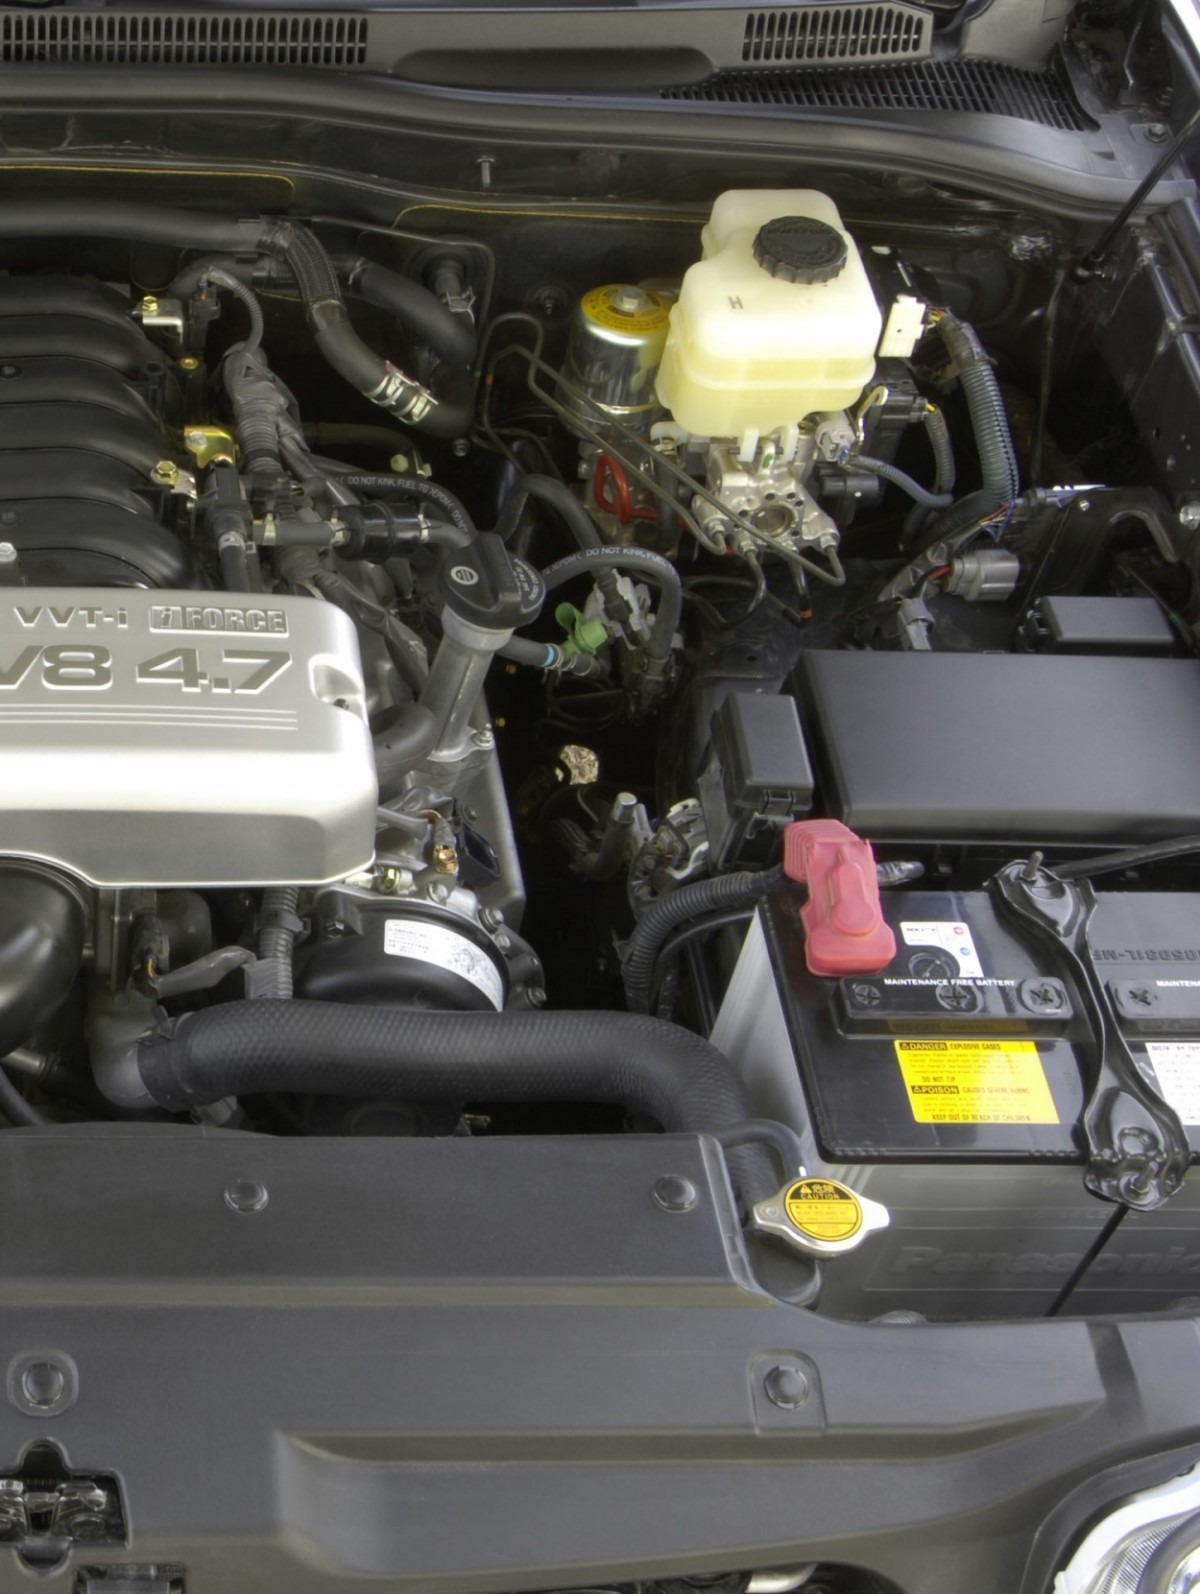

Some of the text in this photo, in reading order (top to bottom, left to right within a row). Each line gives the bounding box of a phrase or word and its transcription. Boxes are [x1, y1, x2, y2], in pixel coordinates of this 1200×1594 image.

[727, 295, 744, 310] H
[348, 476, 361, 486] DO
[361, 477, 377, 486] NOT
[397, 479, 417, 491] FUEL
[585, 547, 600, 558] DO
[601, 546, 621, 556] NOT
[13, 606, 129, 628] VVT-i
[136, 647, 293, 695] 4.7
[884, 978, 1016, 987] MAINTENANCE FREE BATTERY
[1002, 1114, 1031, 1122] CHILDREN
